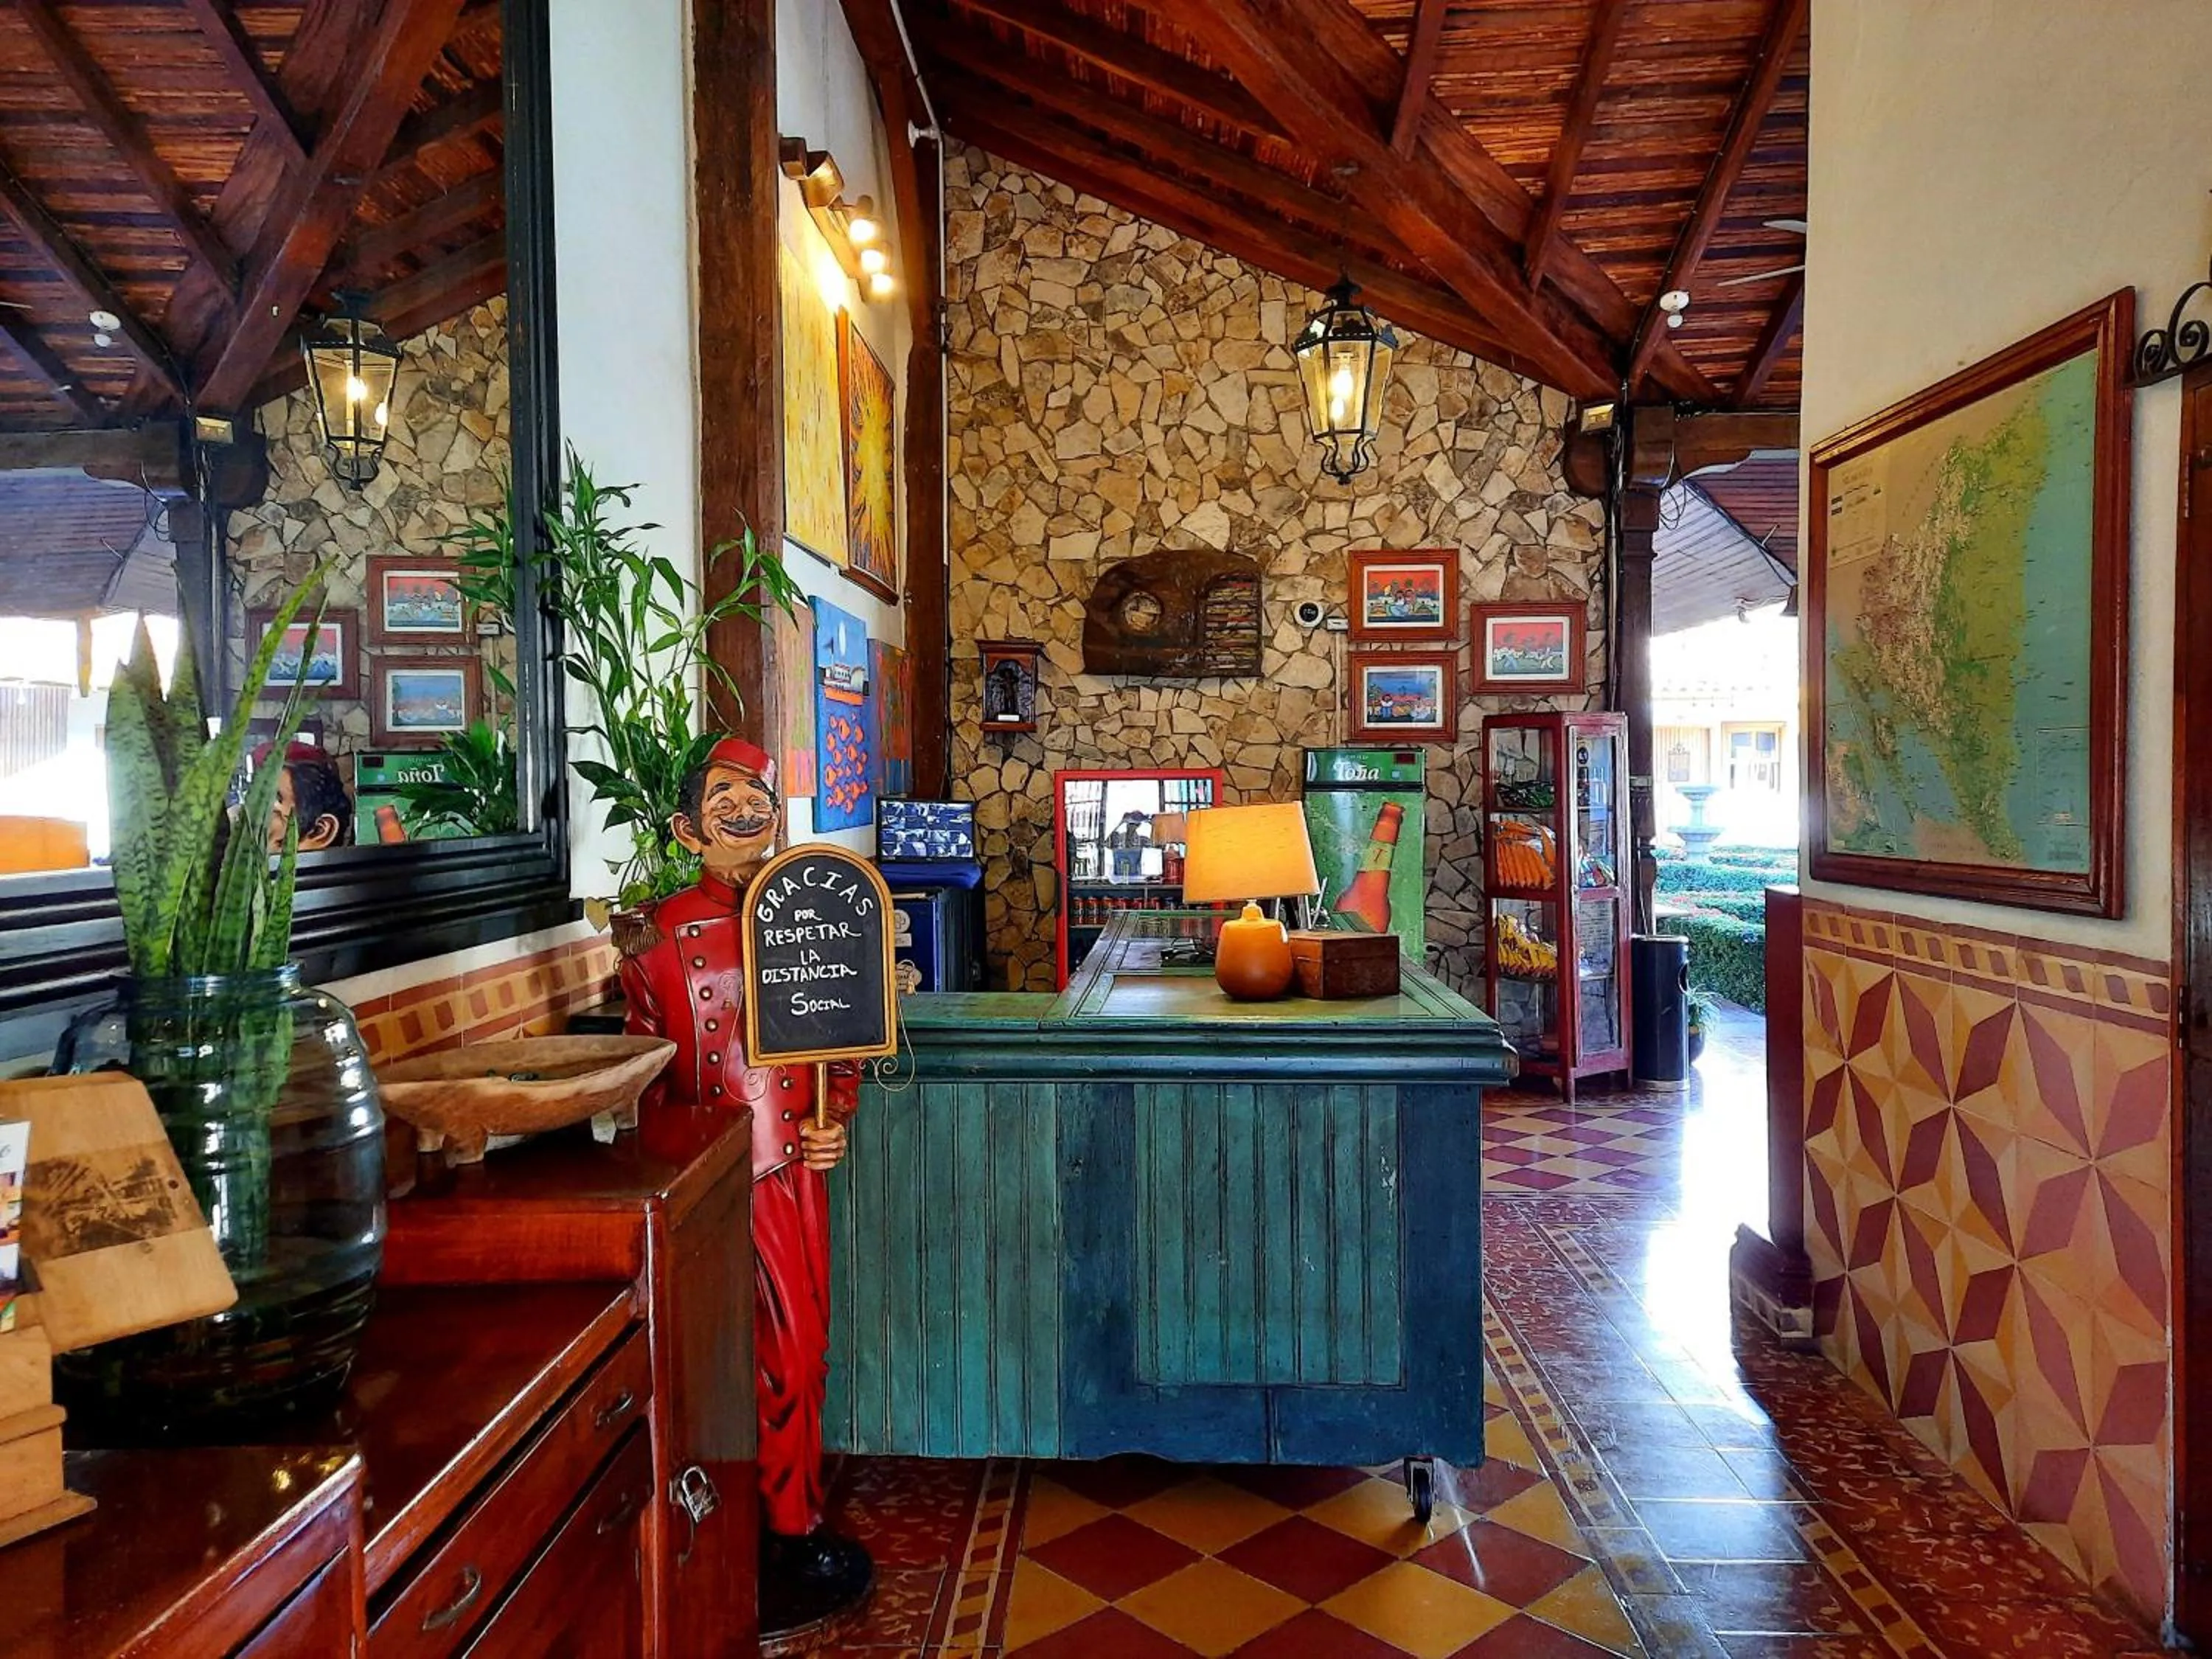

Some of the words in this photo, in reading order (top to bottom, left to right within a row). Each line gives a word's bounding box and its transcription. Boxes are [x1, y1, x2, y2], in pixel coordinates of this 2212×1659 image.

[1333, 760, 1380, 781] Toña
[757, 866, 874, 923] GRACIAS
[794, 908, 822, 922] POR
[764, 922, 862, 947] RESPETAR
[800, 949, 821, 965] LA
[762, 964, 858, 984] DISTANCIA
